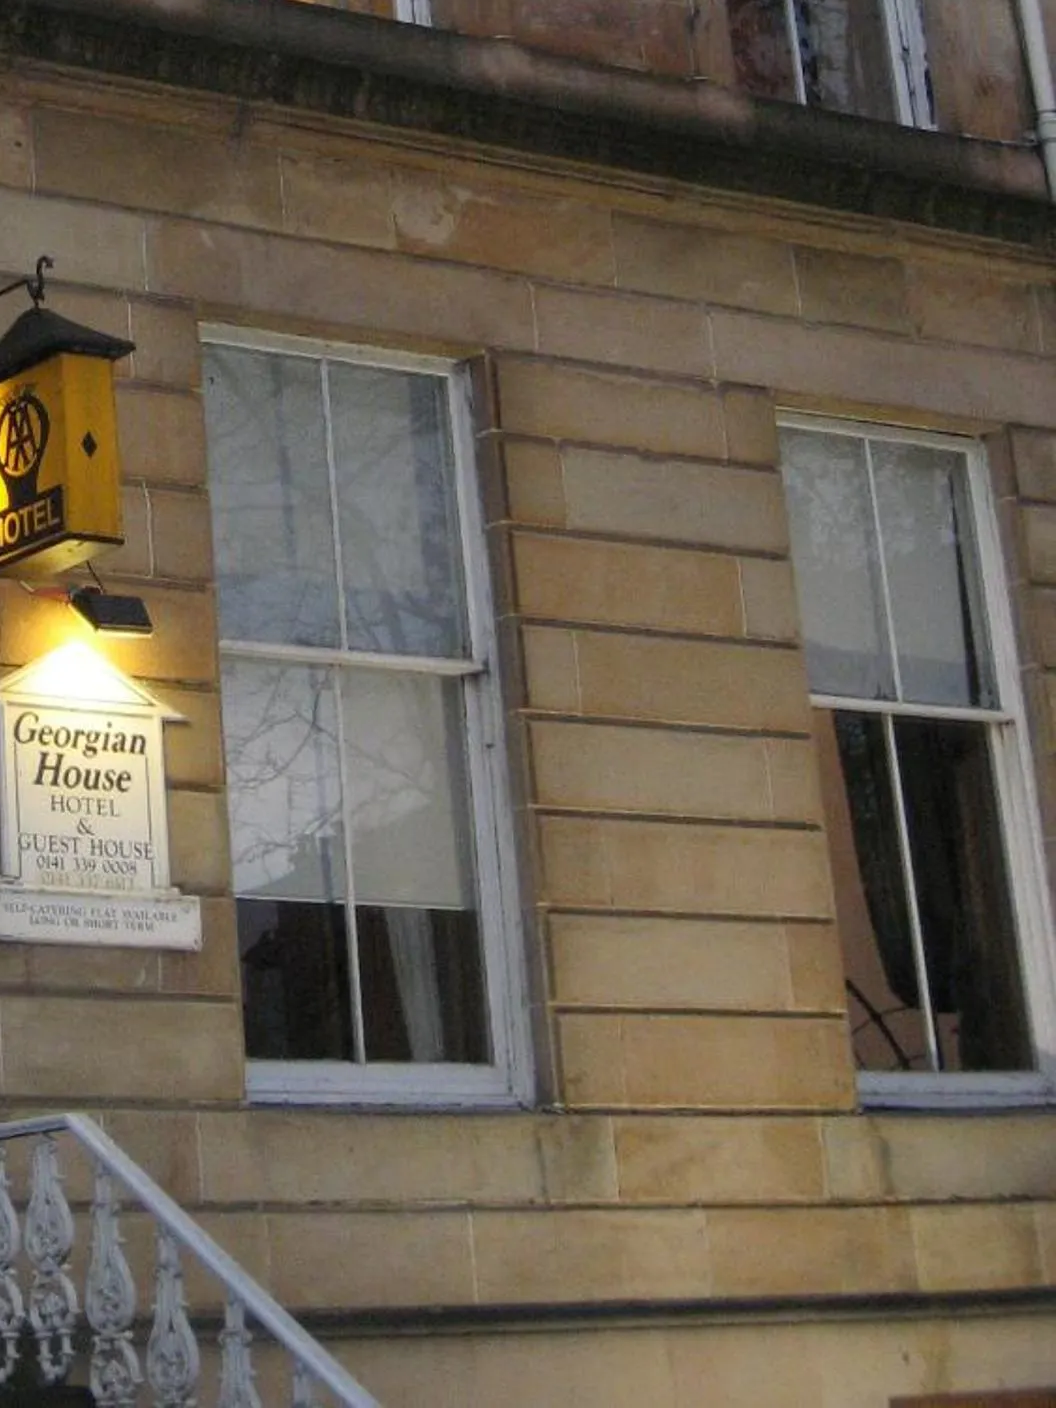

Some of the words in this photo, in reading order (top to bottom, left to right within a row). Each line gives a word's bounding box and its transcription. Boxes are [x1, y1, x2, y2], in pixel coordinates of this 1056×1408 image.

[13, 711, 147, 758] Georgian
[34, 751, 132, 793] House
[50, 794, 121, 818] HOTEL
[76, 817, 95, 836] &
[18, 832, 81, 855] GUEST
[89, 838, 155, 861] HOUSE
[36, 855, 65, 871] 0141
[72, 859, 97, 873] 339
[102, 859, 138, 875] 0008
[29, 914, 60, 927] LONG
[63, 917, 80, 928] OR
[82, 918, 120, 930] SHORT
[124, 920, 156, 933] TERM
[90, 908, 117, 919] FLAT
[122, 909, 178, 923] AVAILABLE
